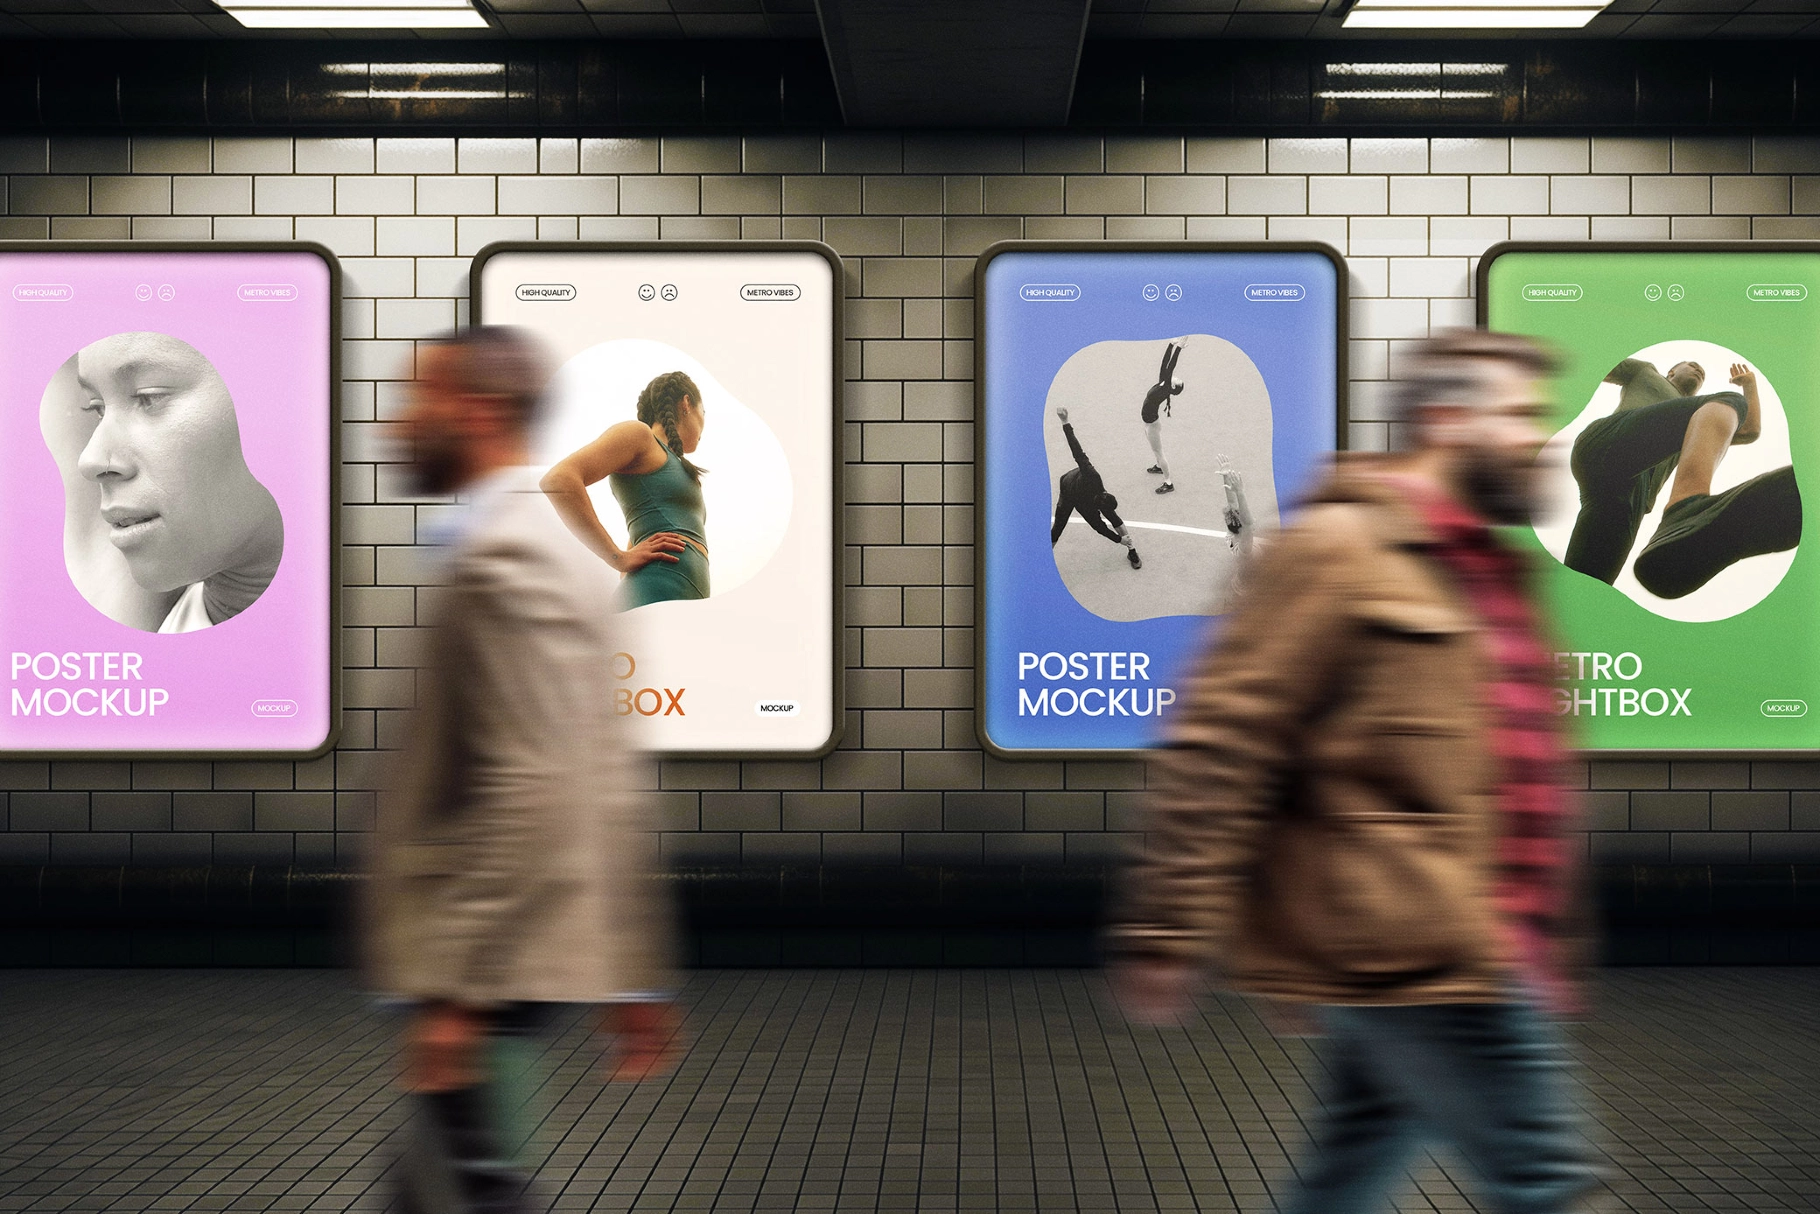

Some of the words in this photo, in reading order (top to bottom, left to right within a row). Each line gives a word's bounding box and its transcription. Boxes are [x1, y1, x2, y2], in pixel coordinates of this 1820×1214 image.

[19, 288, 38, 297] HIGH
[38, 288, 67, 297] QUALITY
[244, 288, 270, 297] METRO
[270, 288, 291, 297] VIBES
[522, 288, 541, 297] HIGH
[541, 288, 570, 297] QUALITY
[747, 288, 773, 297] METRO
[773, 288, 794, 297] VIBES
[1026, 288, 1045, 297] HIGH
[1045, 288, 1074, 297] QUALITY
[1251, 288, 1277, 297] METRO
[1277, 288, 1298, 297] VIBES
[1529, 288, 1548, 297] HIGH
[1548, 288, 1577, 297] QUALITY
[1754, 288, 1780, 297] METRO
[1780, 288, 1801, 297] VIBES
[11, 652, 143, 680] POSTER
[1018, 652, 1150, 680] POSTER
[1553, 652, 1643, 680] ETRO
[11, 688, 170, 716] MOCKUP
[1018, 688, 1177, 716] MOCKUP
[1549, 688, 1693, 716] GHTBOX
[257, 703, 291, 713] MOCKUP
[760, 703, 794, 713] MOCKUP
[1766, 703, 1801, 713] MOCKUP
